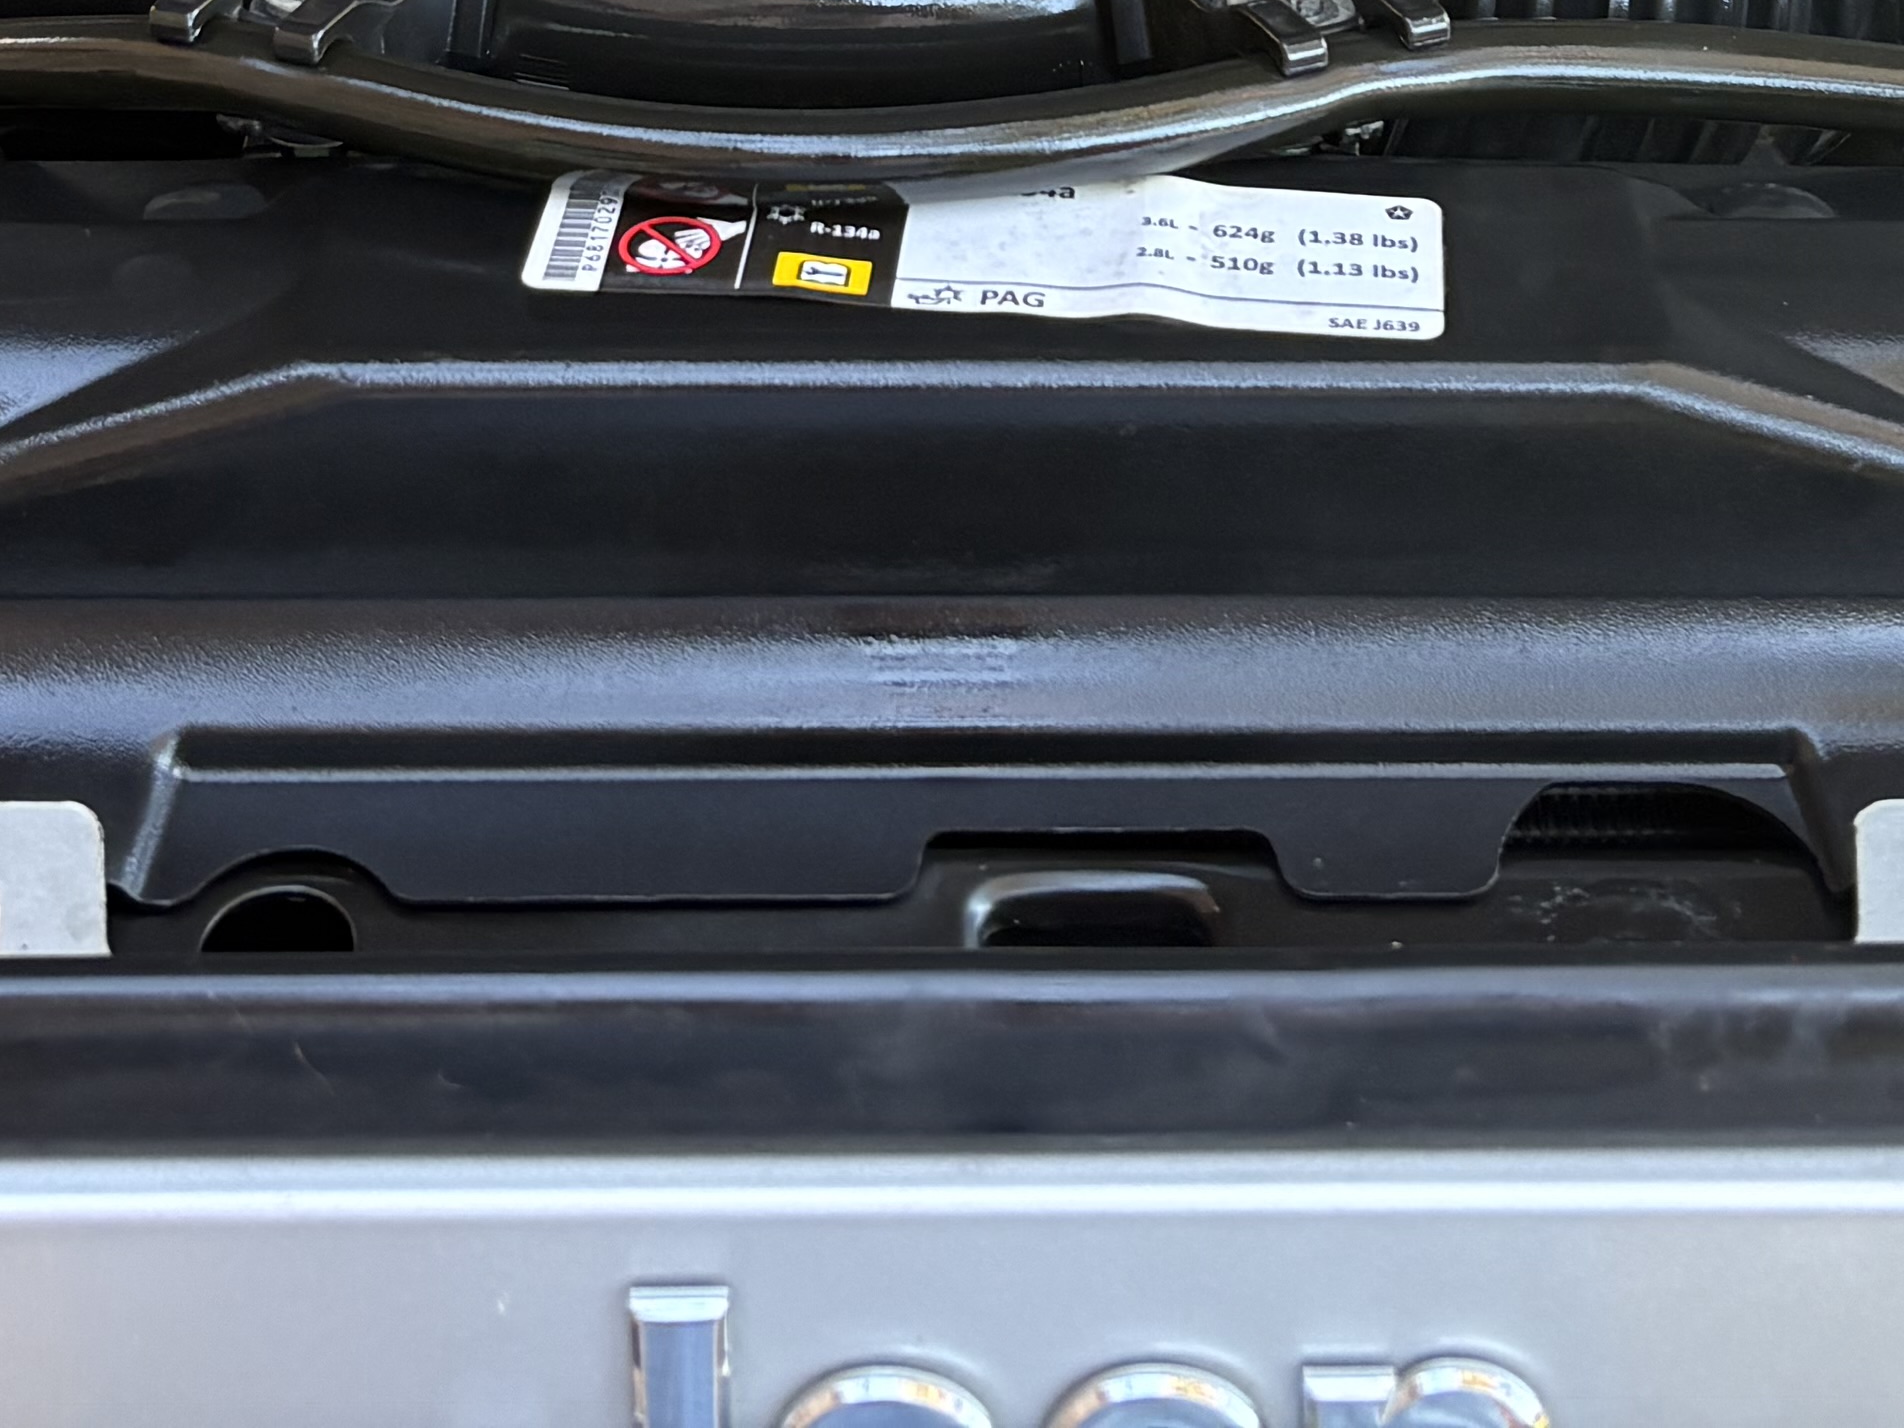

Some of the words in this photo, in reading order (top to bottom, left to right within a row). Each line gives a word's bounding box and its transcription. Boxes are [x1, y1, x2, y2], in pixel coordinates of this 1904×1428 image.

[810, 222, 880, 240] R-134a
[1141, 216, 1179, 230] 3.6L
[1213, 224, 1275, 244] 624g
[1298, 228, 1363, 247] (1.38
[1372, 233, 1419, 254] lbs)
[1136, 246, 1175, 260] 2.8L
[1210, 255, 1274, 276] 510g
[1297, 259, 1363, 278] (1.13
[1372, 264, 1419, 284] lbs)
[980, 289, 1046, 308] PAG
[1328, 317, 1368, 331] SAE
[1372, 318, 1421, 333] J639
